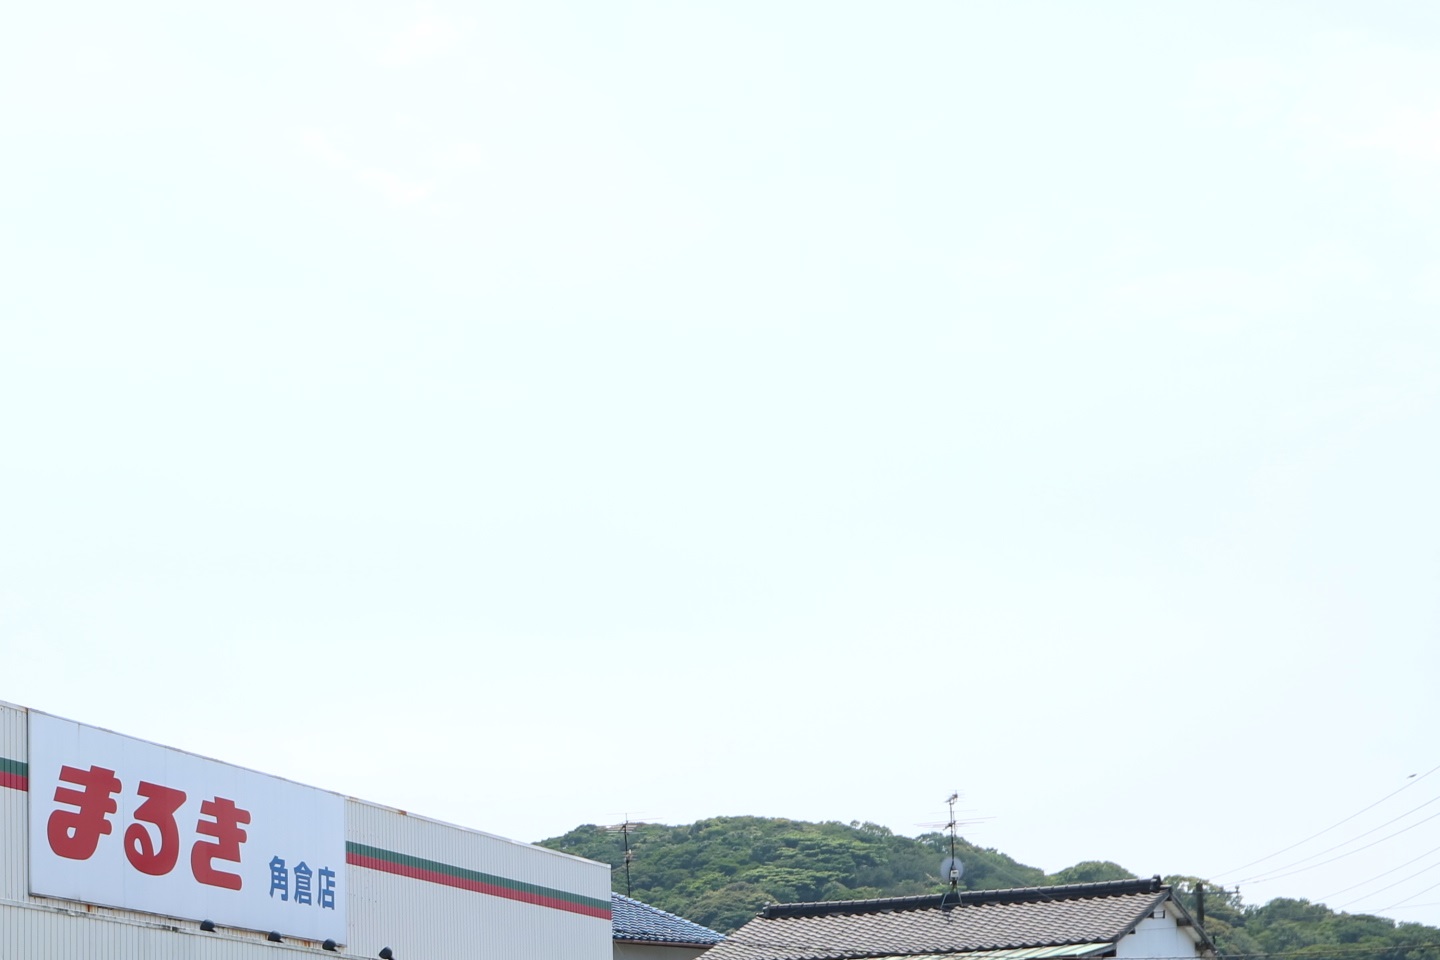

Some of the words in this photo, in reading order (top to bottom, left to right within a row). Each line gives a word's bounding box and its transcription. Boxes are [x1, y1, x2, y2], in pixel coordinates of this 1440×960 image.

[47, 764, 252, 891] まるき
[269, 855, 336, 911] 角倉店
